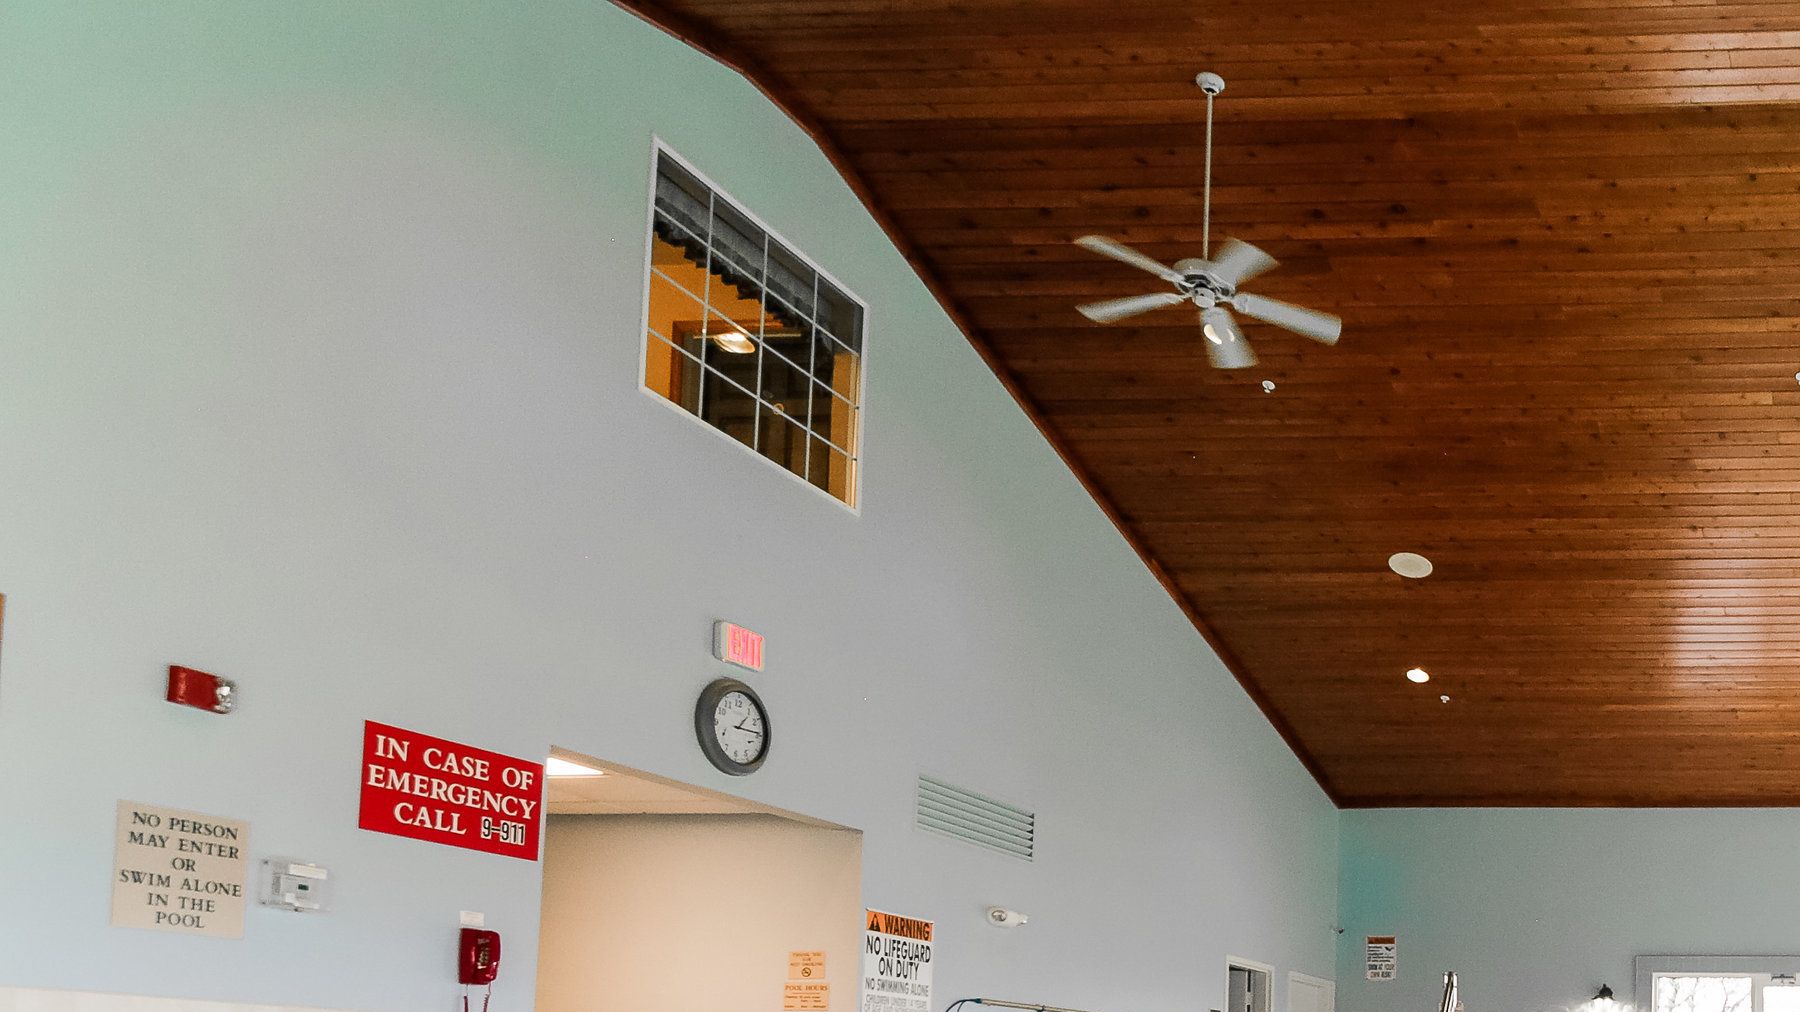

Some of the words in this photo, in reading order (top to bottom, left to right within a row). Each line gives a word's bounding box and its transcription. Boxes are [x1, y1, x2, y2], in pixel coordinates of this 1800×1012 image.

[731, 624, 762, 667] EXIT
[375, 734, 409, 762] IN
[423, 747, 489, 781] CASE
[502, 767, 534, 790] OF
[367, 764, 536, 819] EMERGENCY
[132, 811, 161, 828] NO
[169, 817, 239, 840] PERSON
[393, 802, 467, 834] CALL
[482, 818, 525, 843] 9-911
[128, 831, 169, 848] MAY
[178, 838, 239, 859] ENTER
[172, 857, 196, 872] OR
[119, 869, 171, 888] SWIM
[180, 878, 242, 897] ALONE
[147, 893, 169, 906] IN
[178, 896, 215, 913] THE
[155, 911, 205, 929] POOL
[884, 914, 930, 941] WARNING
[866, 935, 881, 955] NO
[884, 938, 931, 963] LIFEGUARD
[879, 957, 893, 976] ON
[896, 960, 920, 980] DUTY
[865, 977, 875, 991] NO
[877, 978, 909, 996] SWIMMING
[910, 983, 929, 998] ALONE
